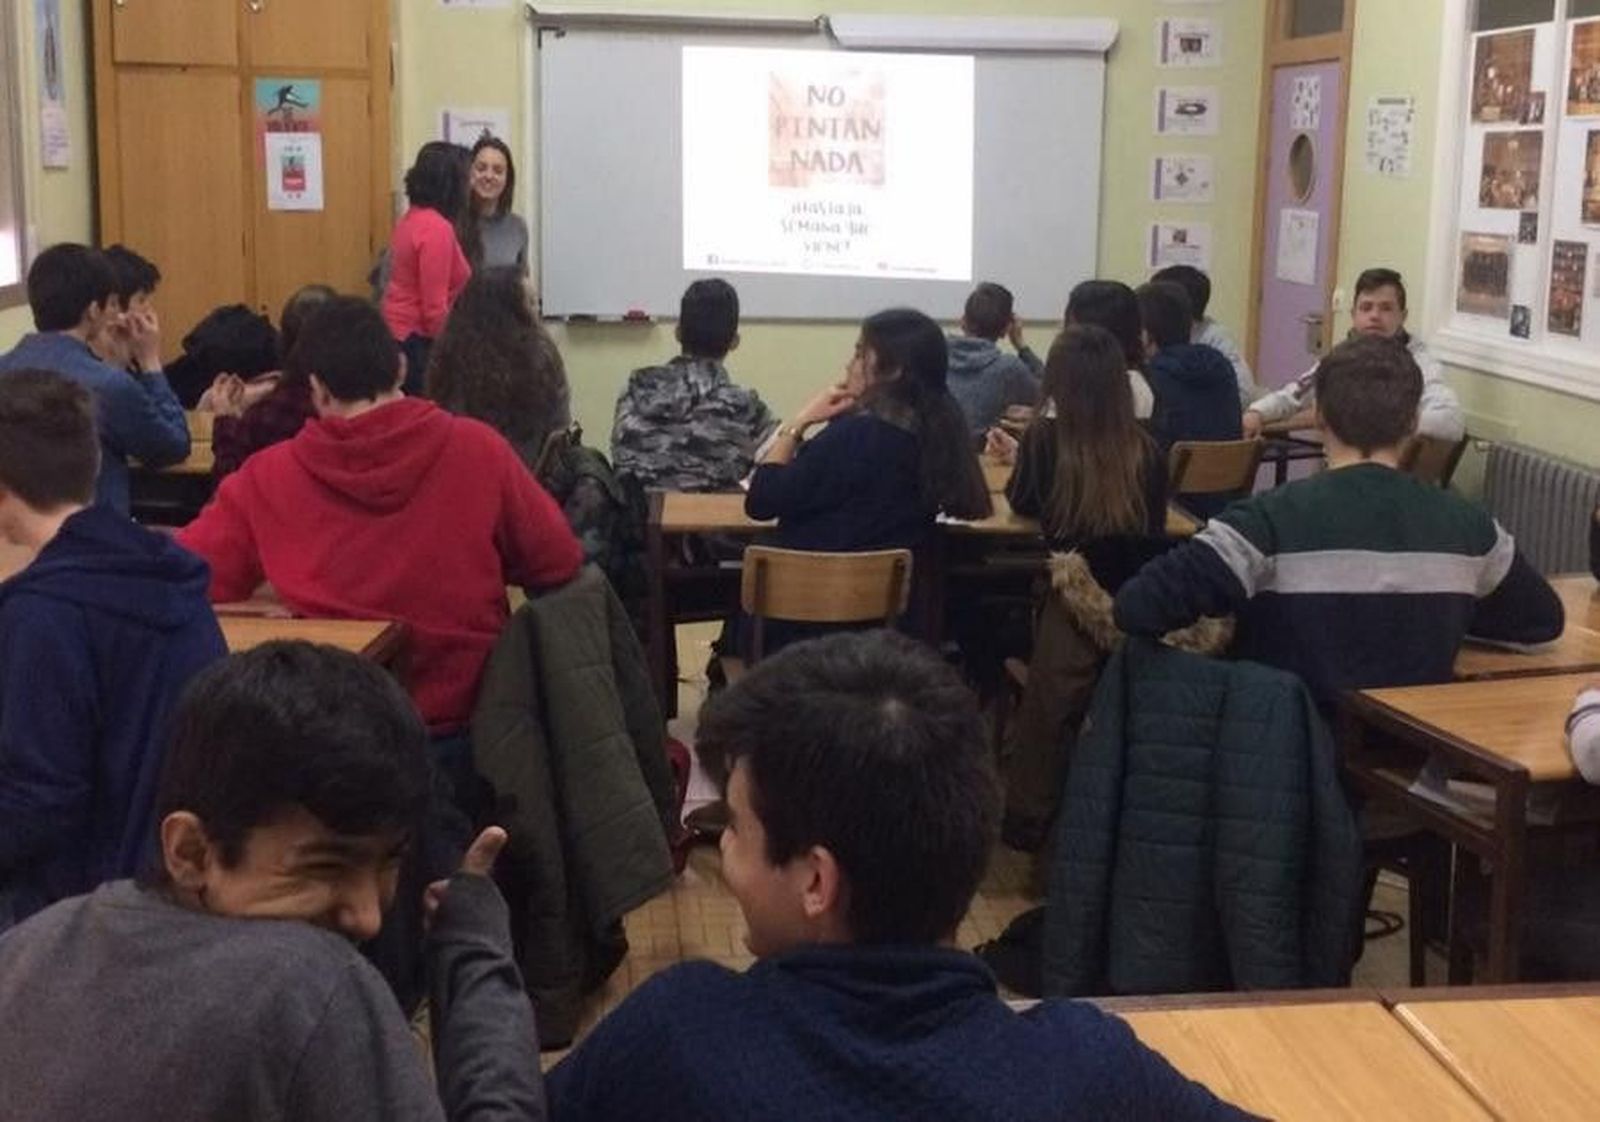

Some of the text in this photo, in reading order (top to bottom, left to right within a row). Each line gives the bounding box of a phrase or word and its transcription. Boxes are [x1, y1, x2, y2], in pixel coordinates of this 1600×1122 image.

[807, 84, 846, 107] NO
[775, 115, 881, 140] PINTAN
[789, 149, 864, 174] NADA
